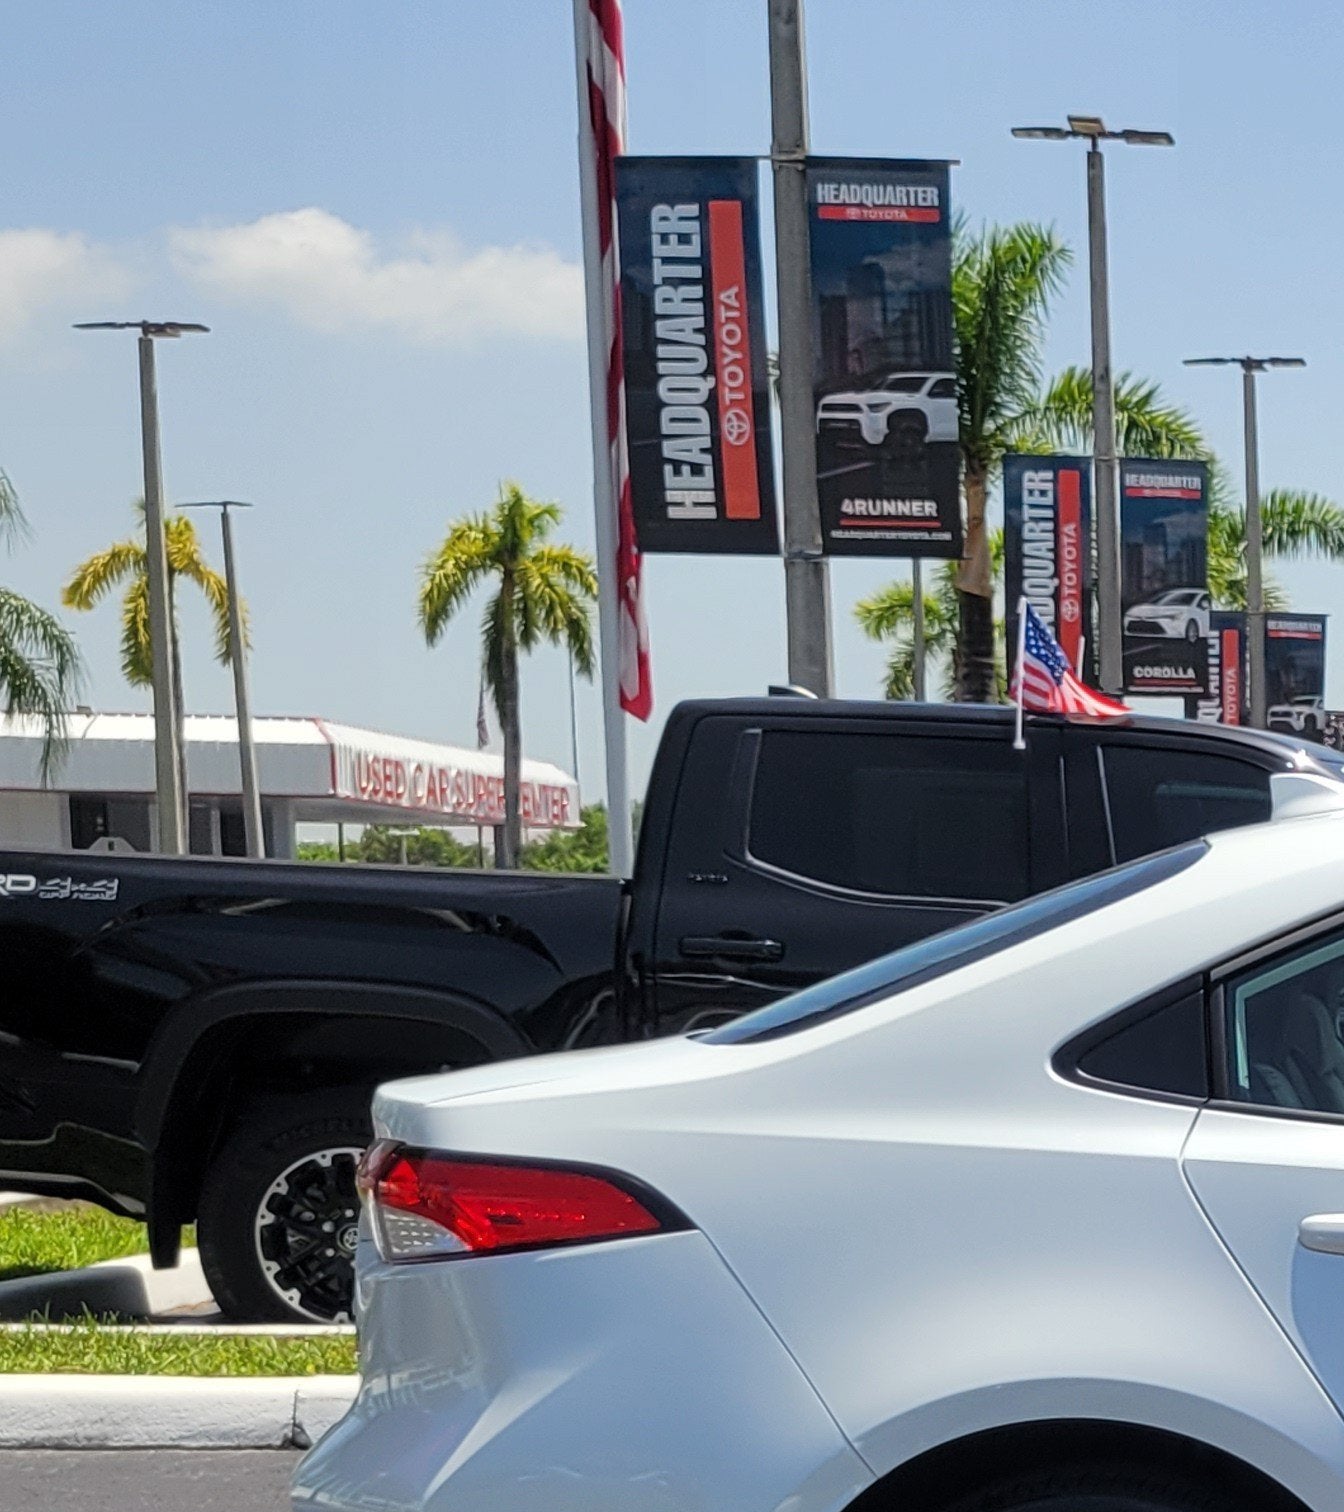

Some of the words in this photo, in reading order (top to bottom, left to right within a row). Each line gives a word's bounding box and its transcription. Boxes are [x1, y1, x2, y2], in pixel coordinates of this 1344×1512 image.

[817, 183, 940, 207] HEADQUARTER
[862, 209, 909, 220] TOYOTA
[651, 202, 718, 520] HEADQUARTER
[718, 286, 746, 405] TOYOTA
[841, 498, 938, 517] 4RUNNER
[1021, 470, 1060, 628] DQUARTER
[1063, 522, 1078, 596] TOYOTA
[1133, 666, 1197, 679] COROLLA
[355, 754, 407, 800] USED
[412, 763, 450, 810] CAR
[520, 781, 570, 823] ENTER
